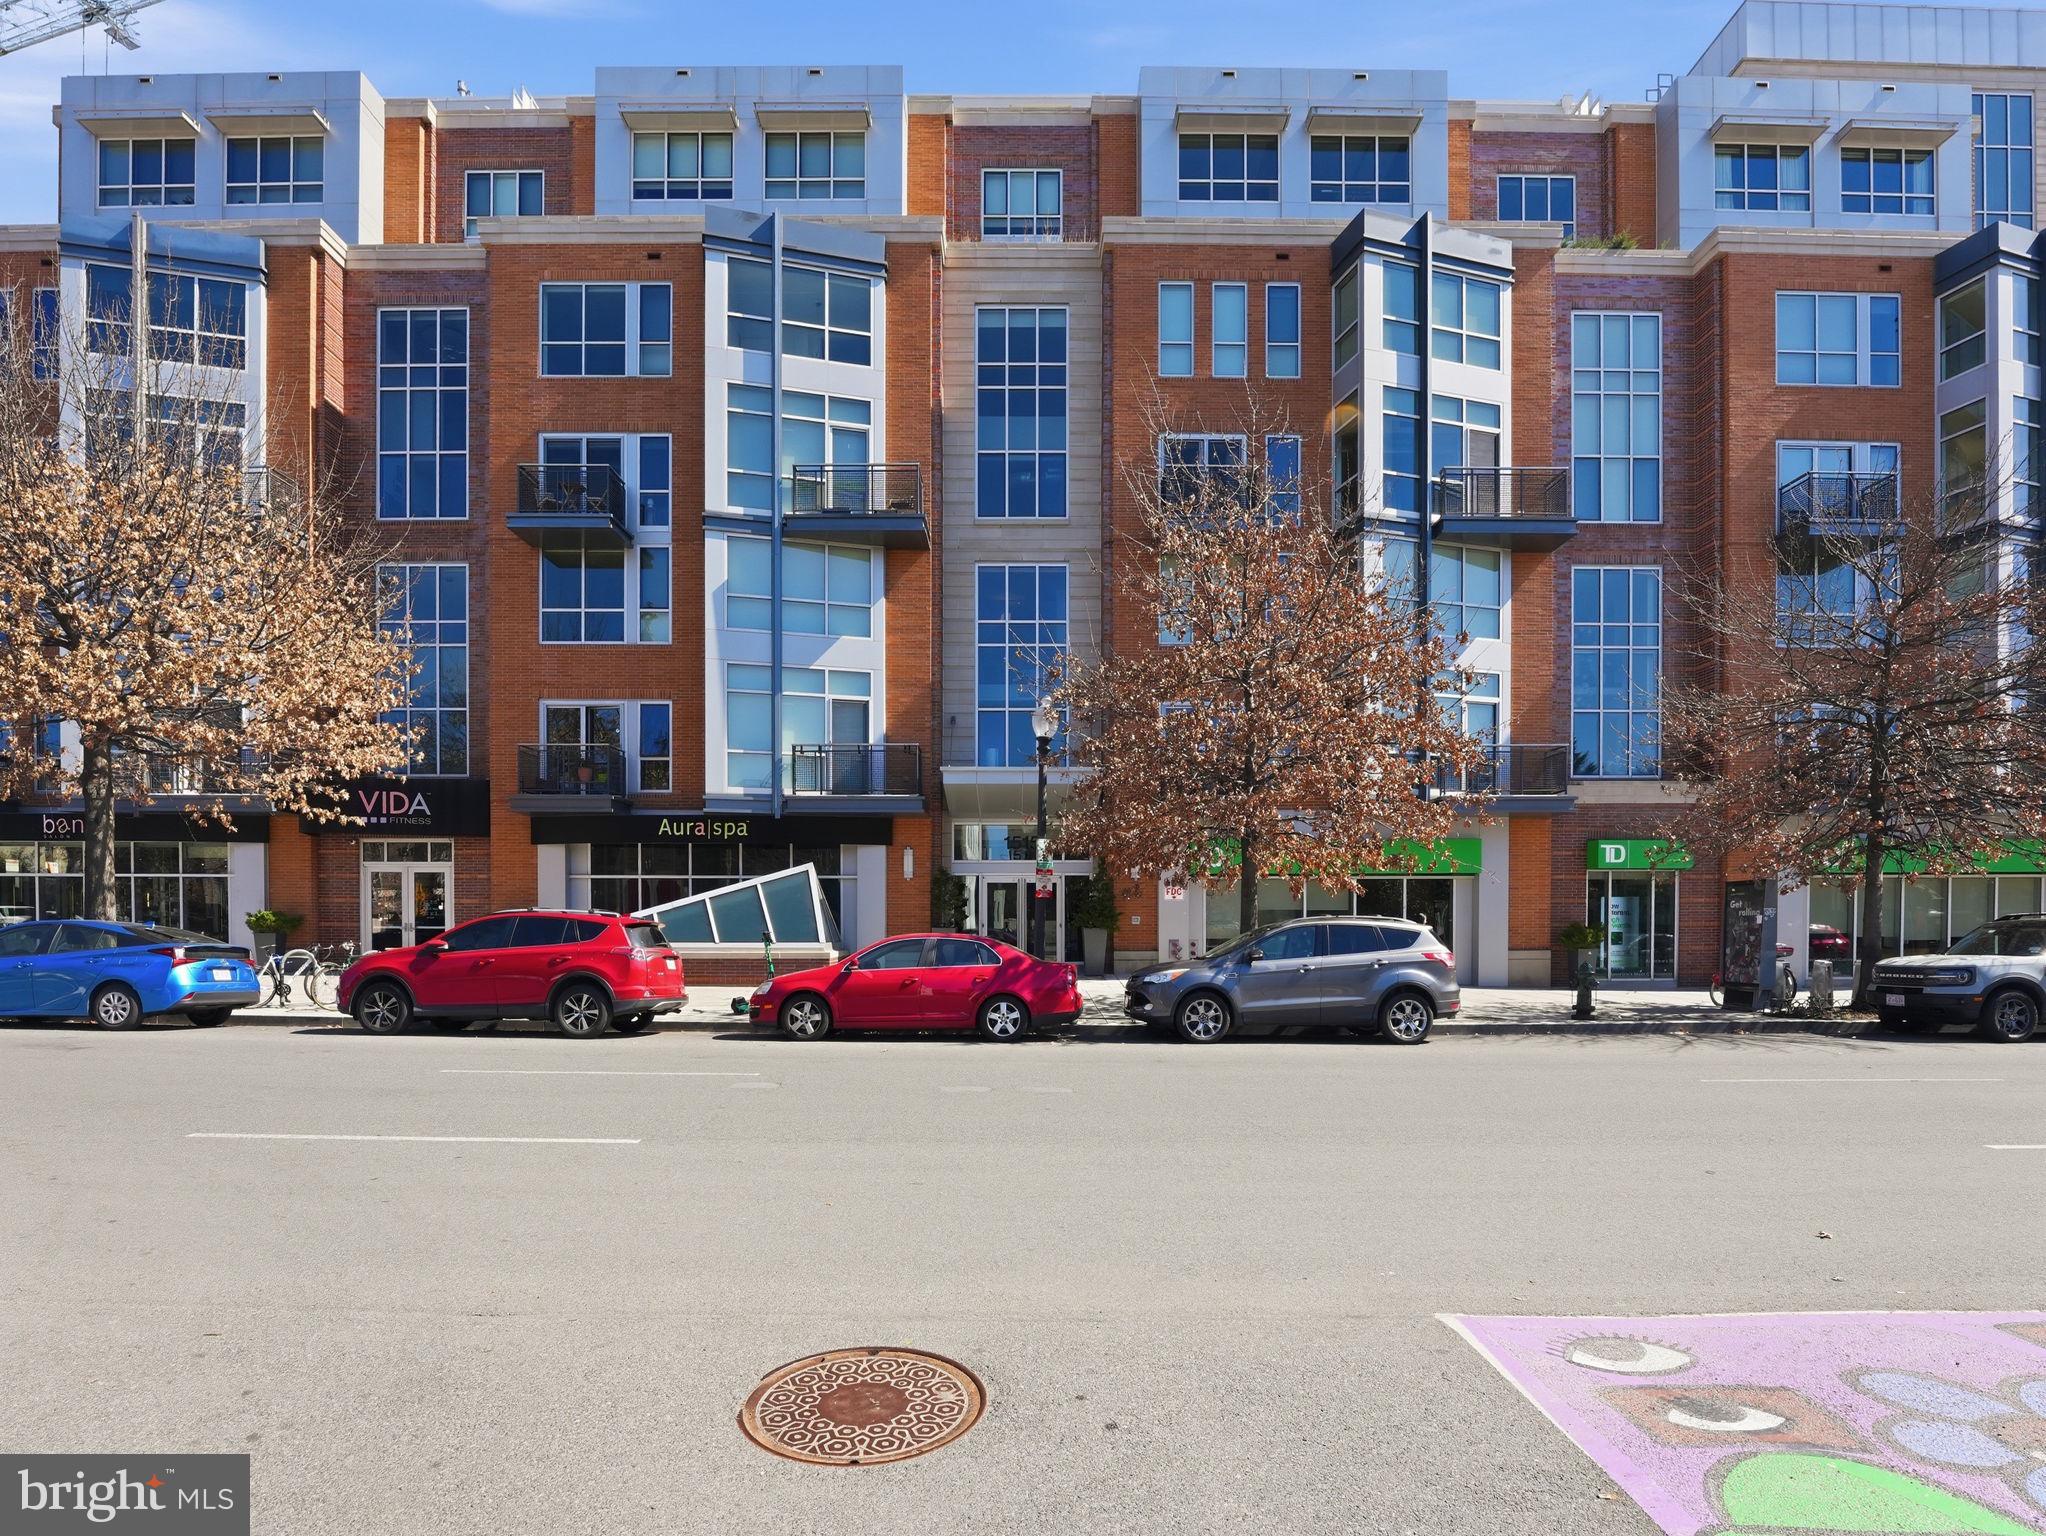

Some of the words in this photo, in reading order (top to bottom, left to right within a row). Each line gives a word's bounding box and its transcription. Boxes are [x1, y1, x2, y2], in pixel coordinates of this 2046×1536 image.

[358, 790, 431, 815] VIDA
[43, 814, 84, 833] ban
[389, 816, 432, 825] FITNESS
[1600, 844, 1626, 863] TD
[1165, 887, 1182, 896] FDC
[1730, 900, 1743, 909] Get
[1738, 908, 1761, 917] rolling
